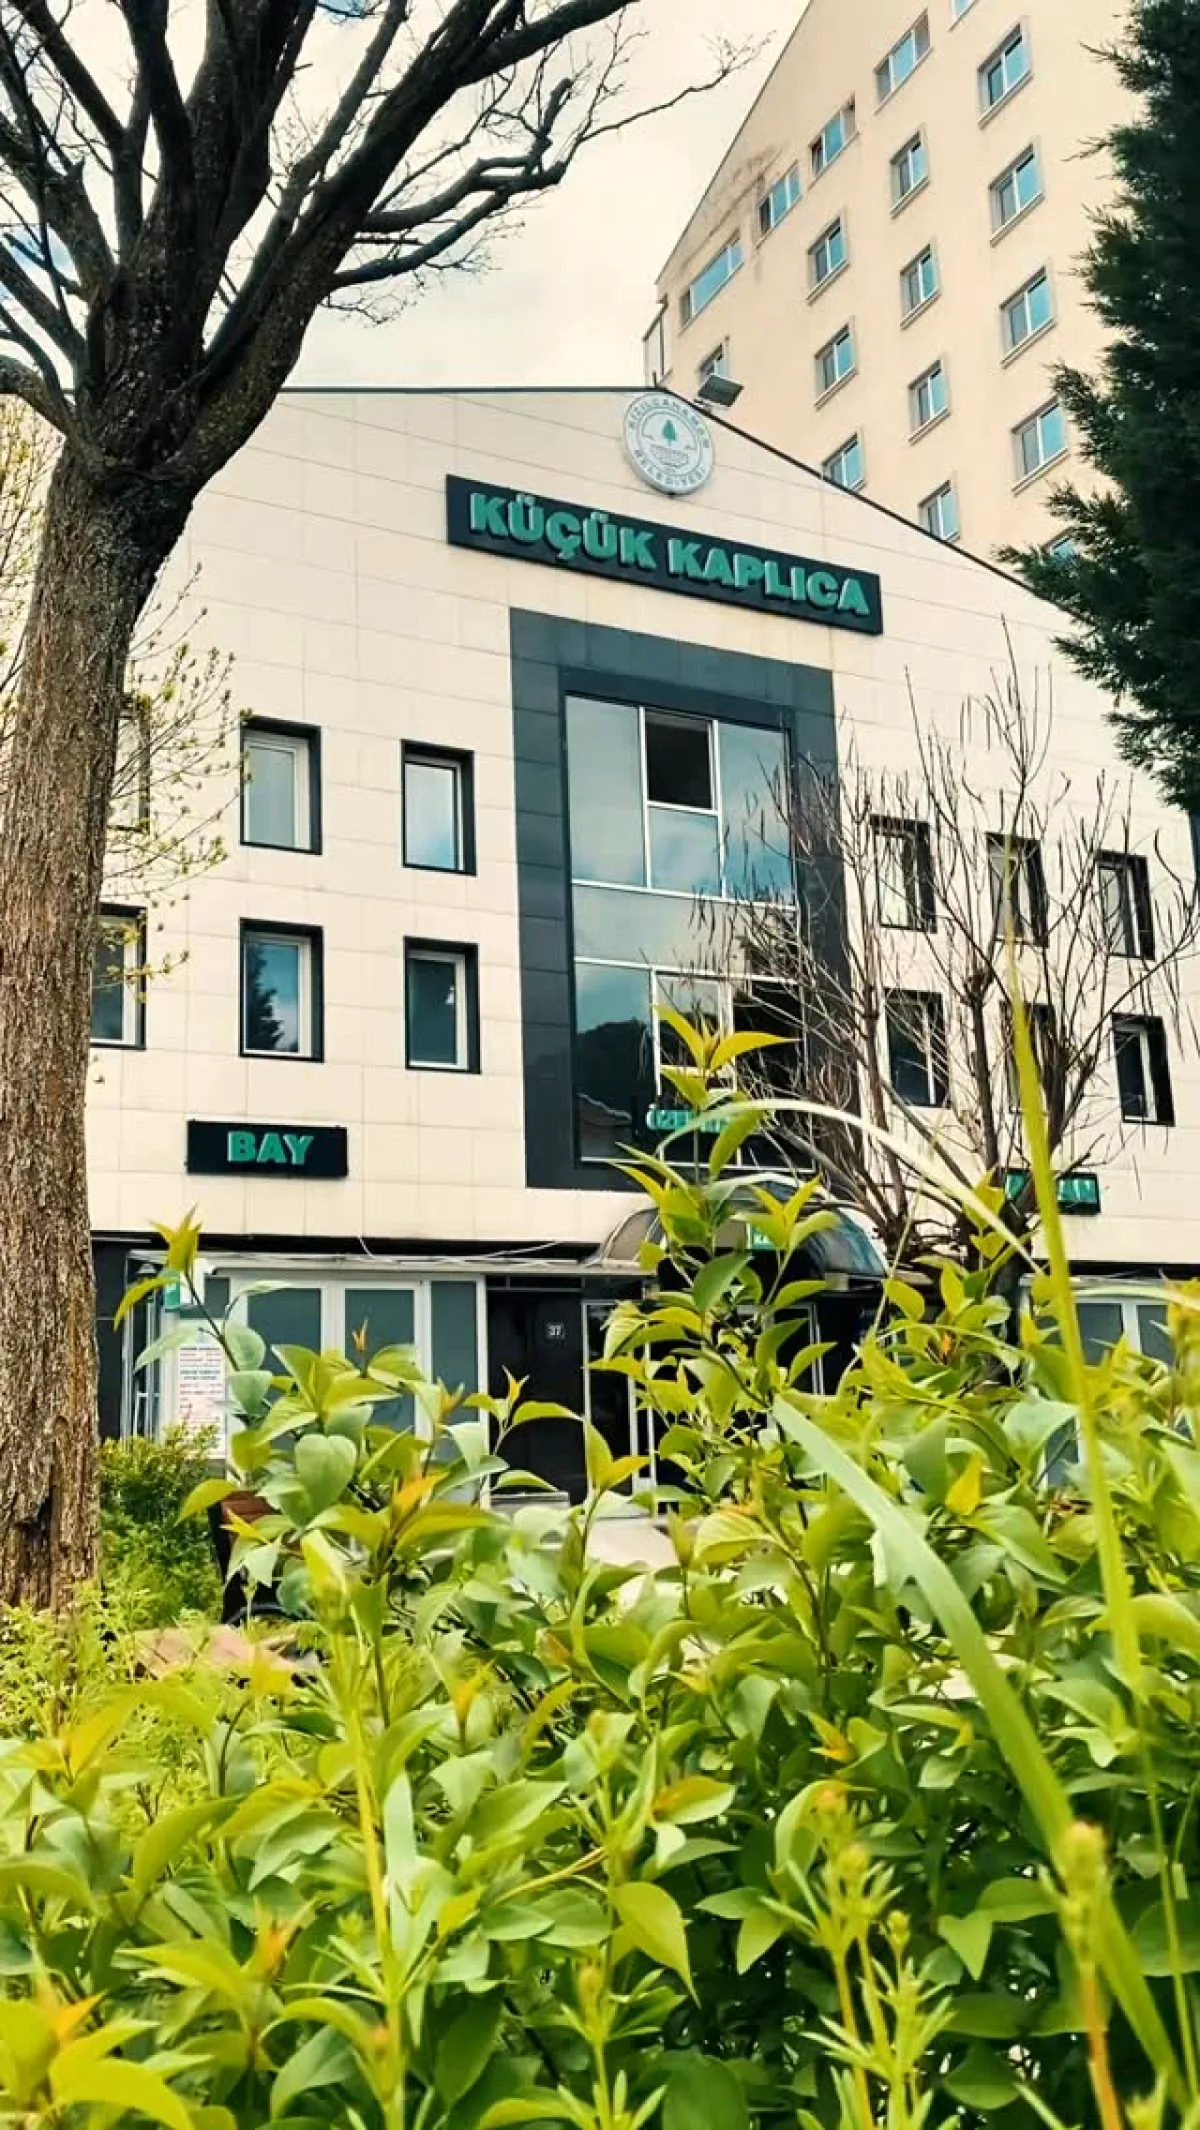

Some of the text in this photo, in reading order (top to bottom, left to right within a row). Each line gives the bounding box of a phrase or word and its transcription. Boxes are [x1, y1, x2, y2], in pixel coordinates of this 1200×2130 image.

[469, 492, 870, 616] KÜÇÜK KAPLICA
[227, 1130, 315, 1165] BAY
